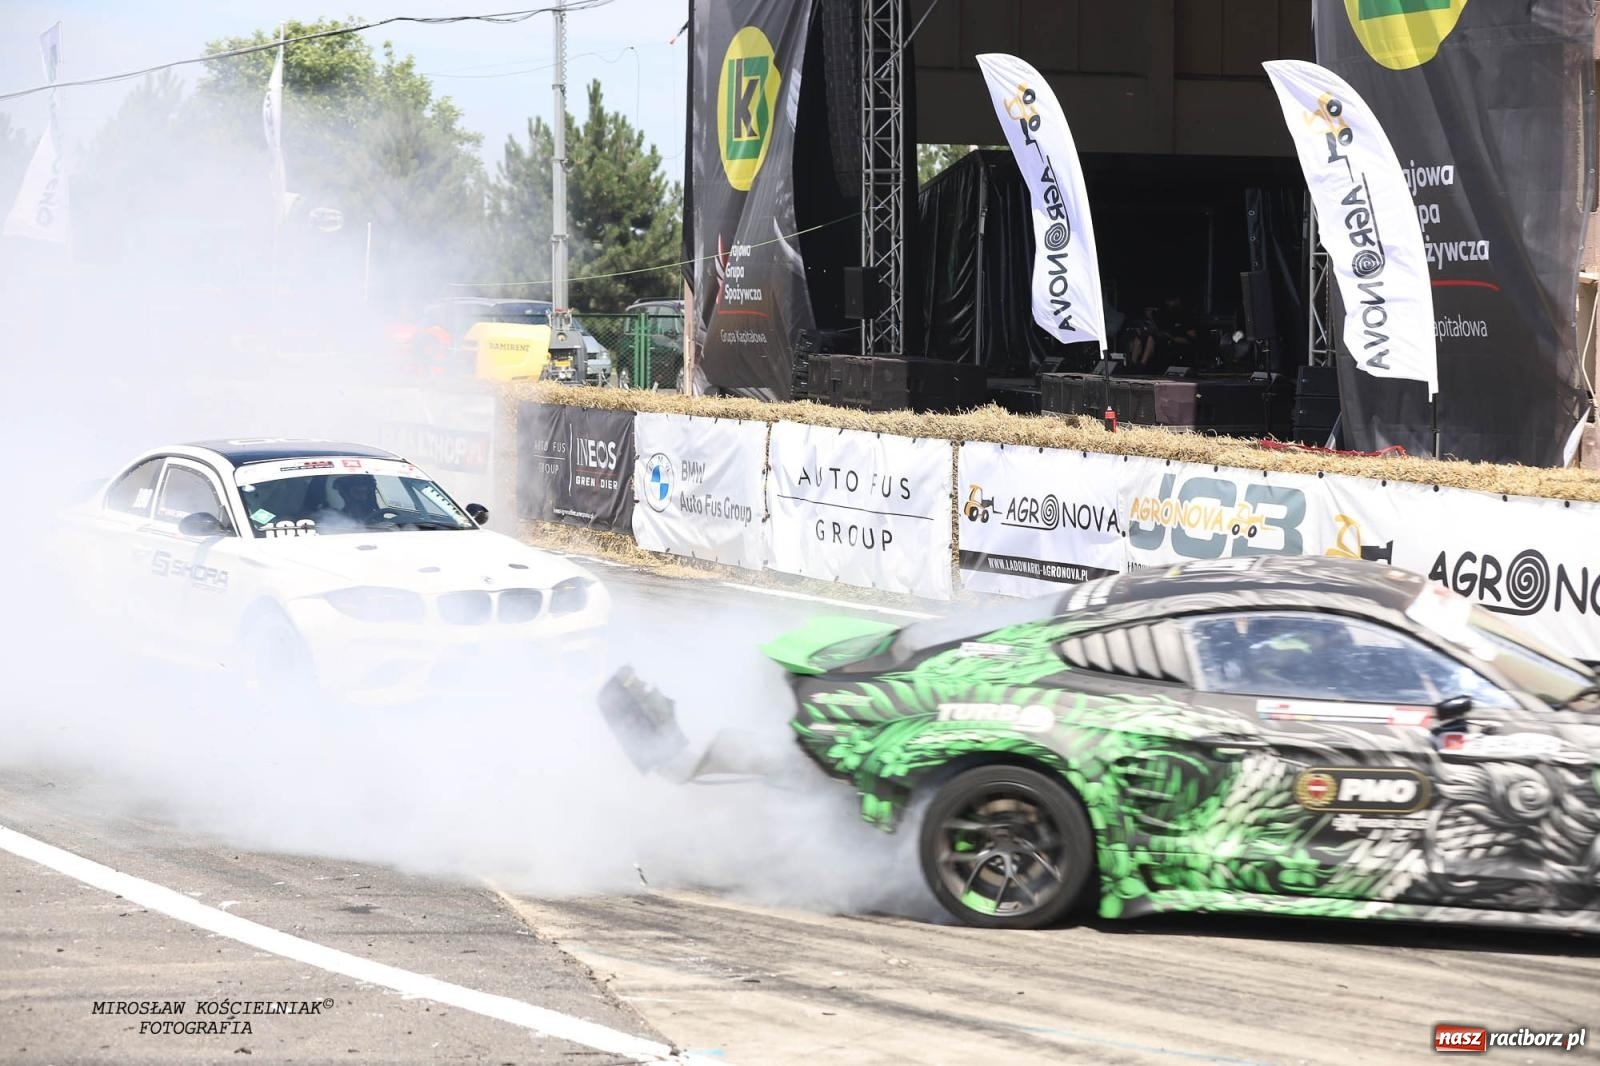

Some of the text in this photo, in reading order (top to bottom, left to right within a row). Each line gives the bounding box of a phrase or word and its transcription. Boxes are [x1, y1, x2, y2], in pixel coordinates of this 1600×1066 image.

[1402, 160, 1455, 196] ajowa
[1424, 235, 1490, 270] żywcza
[725, 262, 745, 283] Grupa
[724, 284, 763, 305] Spożywcza
[576, 437, 617, 471] INEOS
[681, 460, 705, 484] BMW
[798, 467, 911, 500] AUTO FUS
[680, 491, 752, 527] Auto Fus Group
[1130, 497, 1224, 532] AGRONOVA
[815, 519, 893, 551] GROUP
[1338, 778, 1417, 803] PMO
